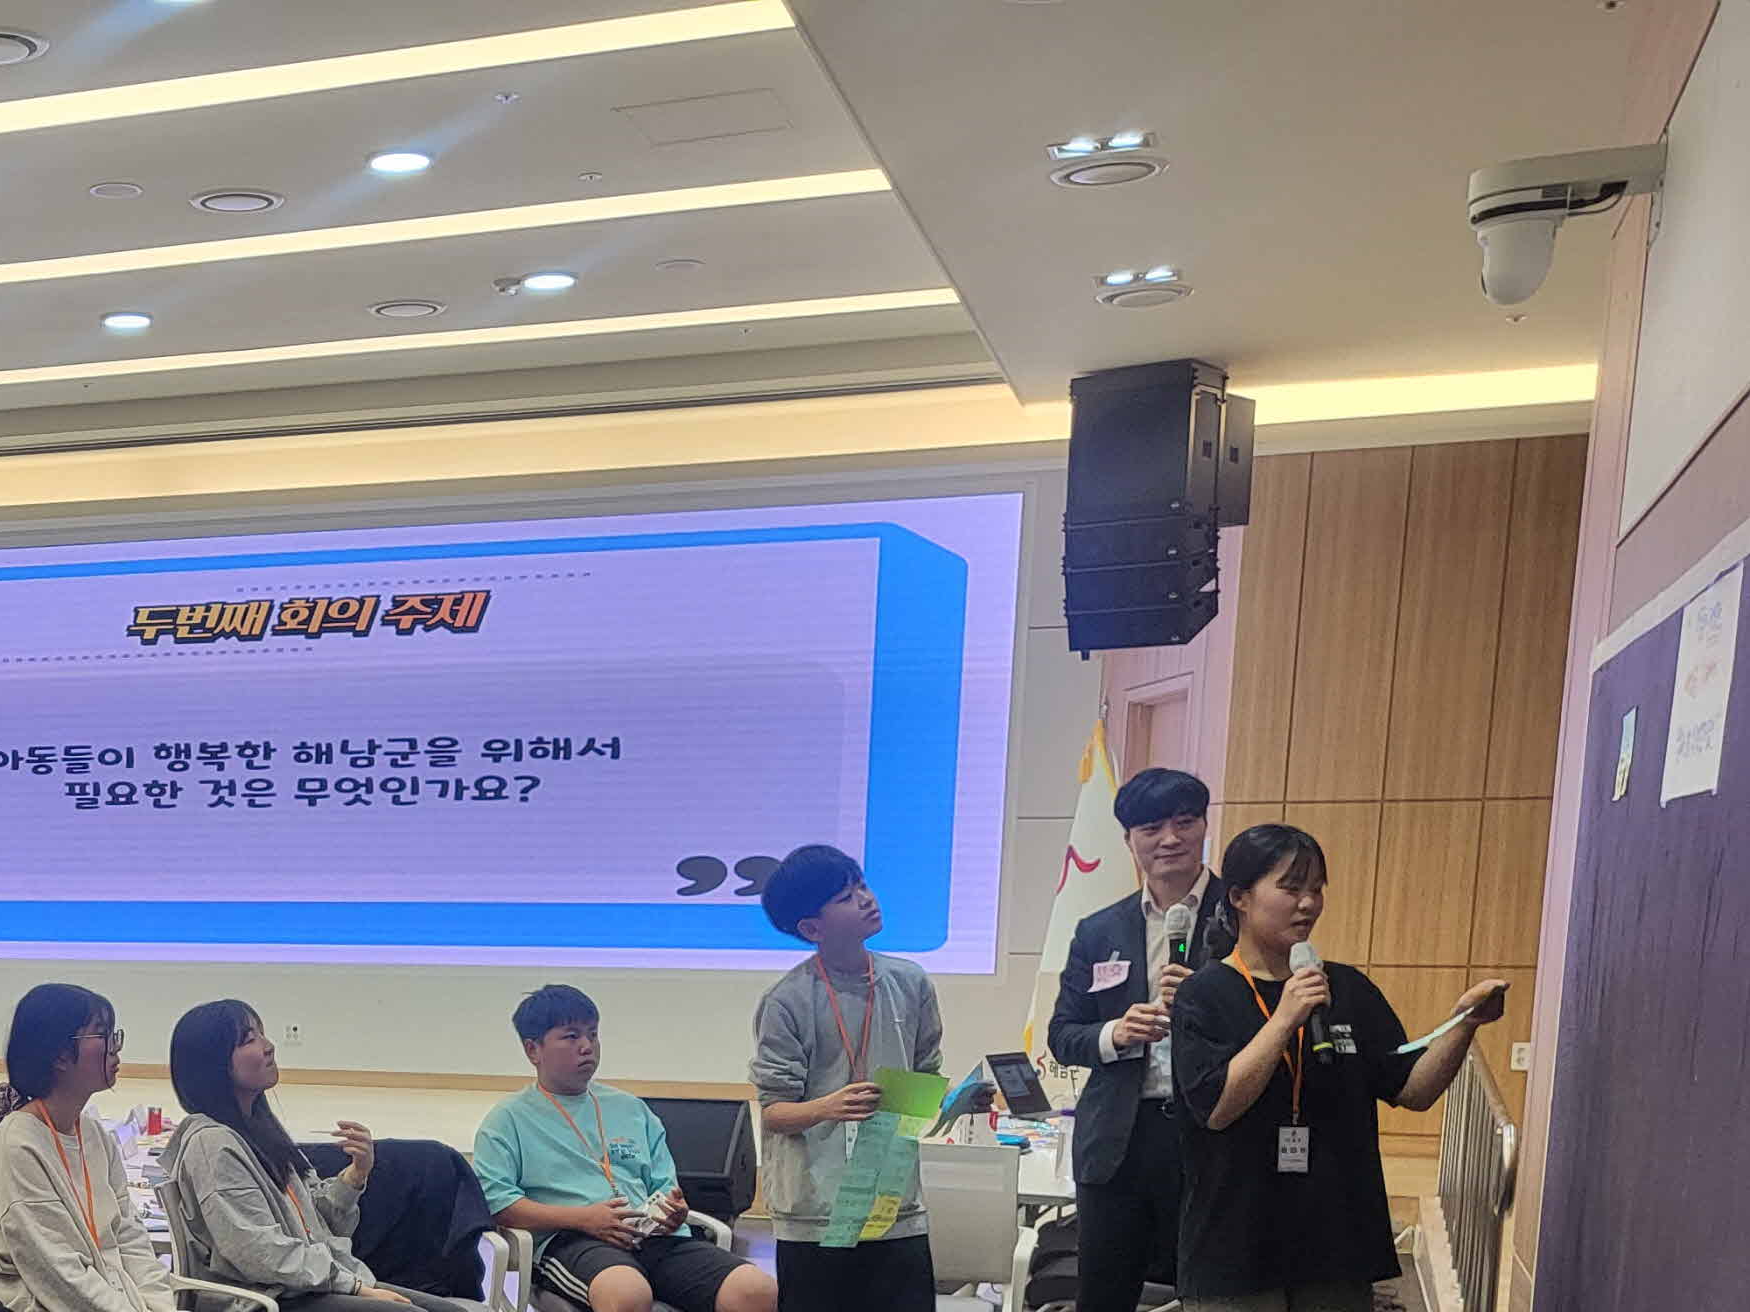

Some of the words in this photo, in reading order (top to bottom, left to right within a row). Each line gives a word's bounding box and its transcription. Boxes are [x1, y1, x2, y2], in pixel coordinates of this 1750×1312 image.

[126, 597, 274, 645] 두번째
[271, 595, 380, 638] 회의
[381, 590, 491, 635] 주제
[153, 741, 276, 772] 행복한
[292, 736, 462, 768] 해남군을
[480, 736, 621, 763] 위해서
[64, 780, 183, 810] 필요한
[198, 777, 276, 809] 것은
[294, 775, 541, 806] 무엇인가요?
